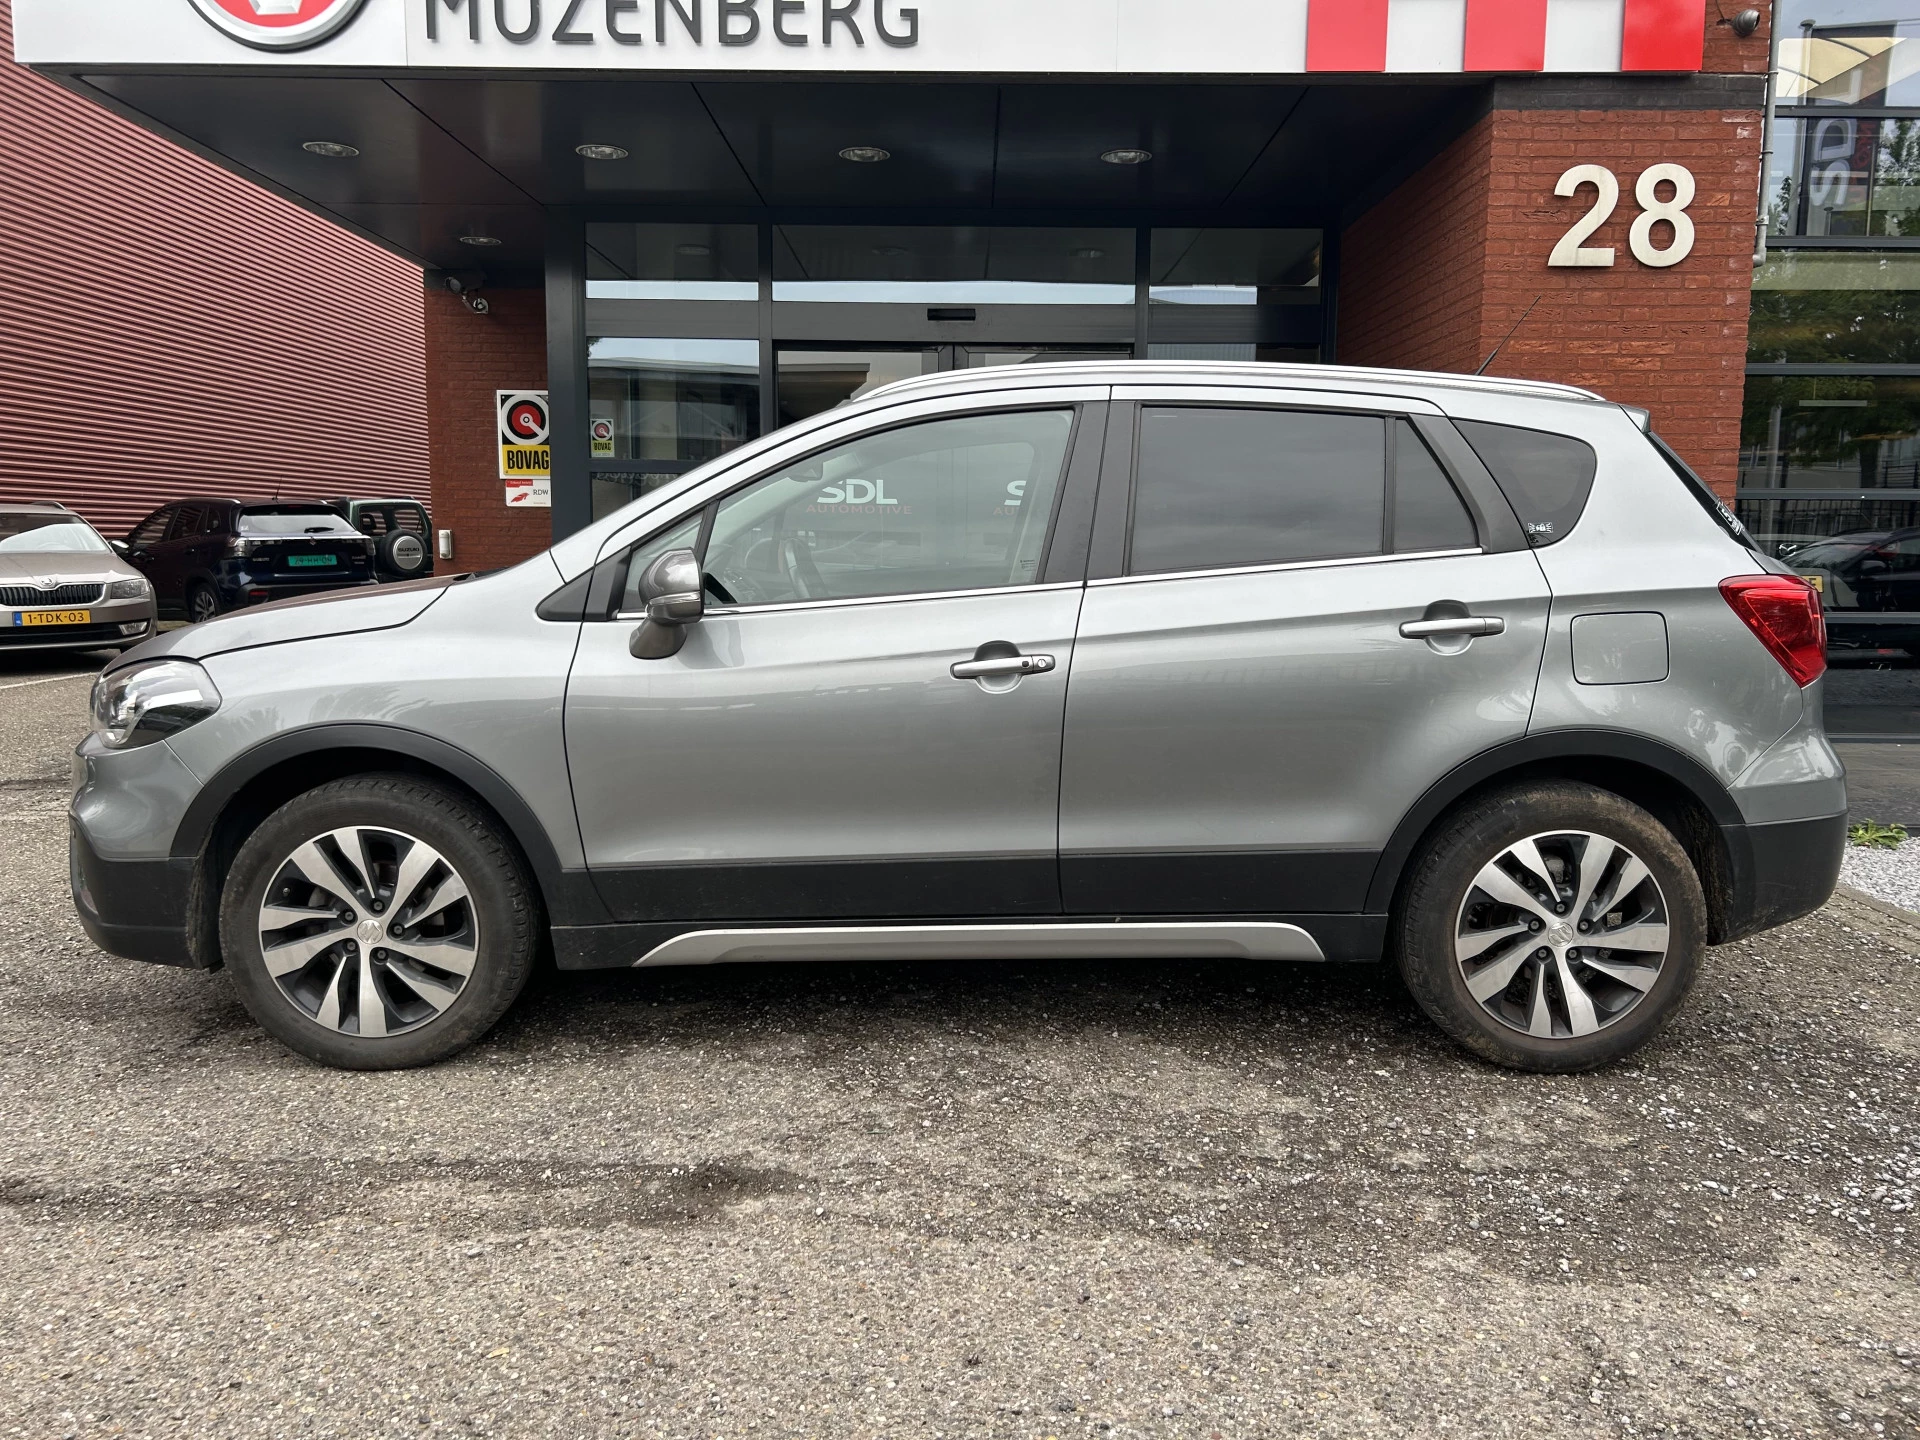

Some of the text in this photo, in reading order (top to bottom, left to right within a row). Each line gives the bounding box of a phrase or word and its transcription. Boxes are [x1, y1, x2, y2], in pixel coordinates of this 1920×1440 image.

[1547, 162, 1696, 268] 28
[593, 442, 611, 451] BOVAG
[506, 450, 550, 470] BOVAG
[816, 478, 899, 505] SDL
[805, 504, 913, 516] AUTOMOTIVE
[27, 612, 85, 624] 1-TDK-03
